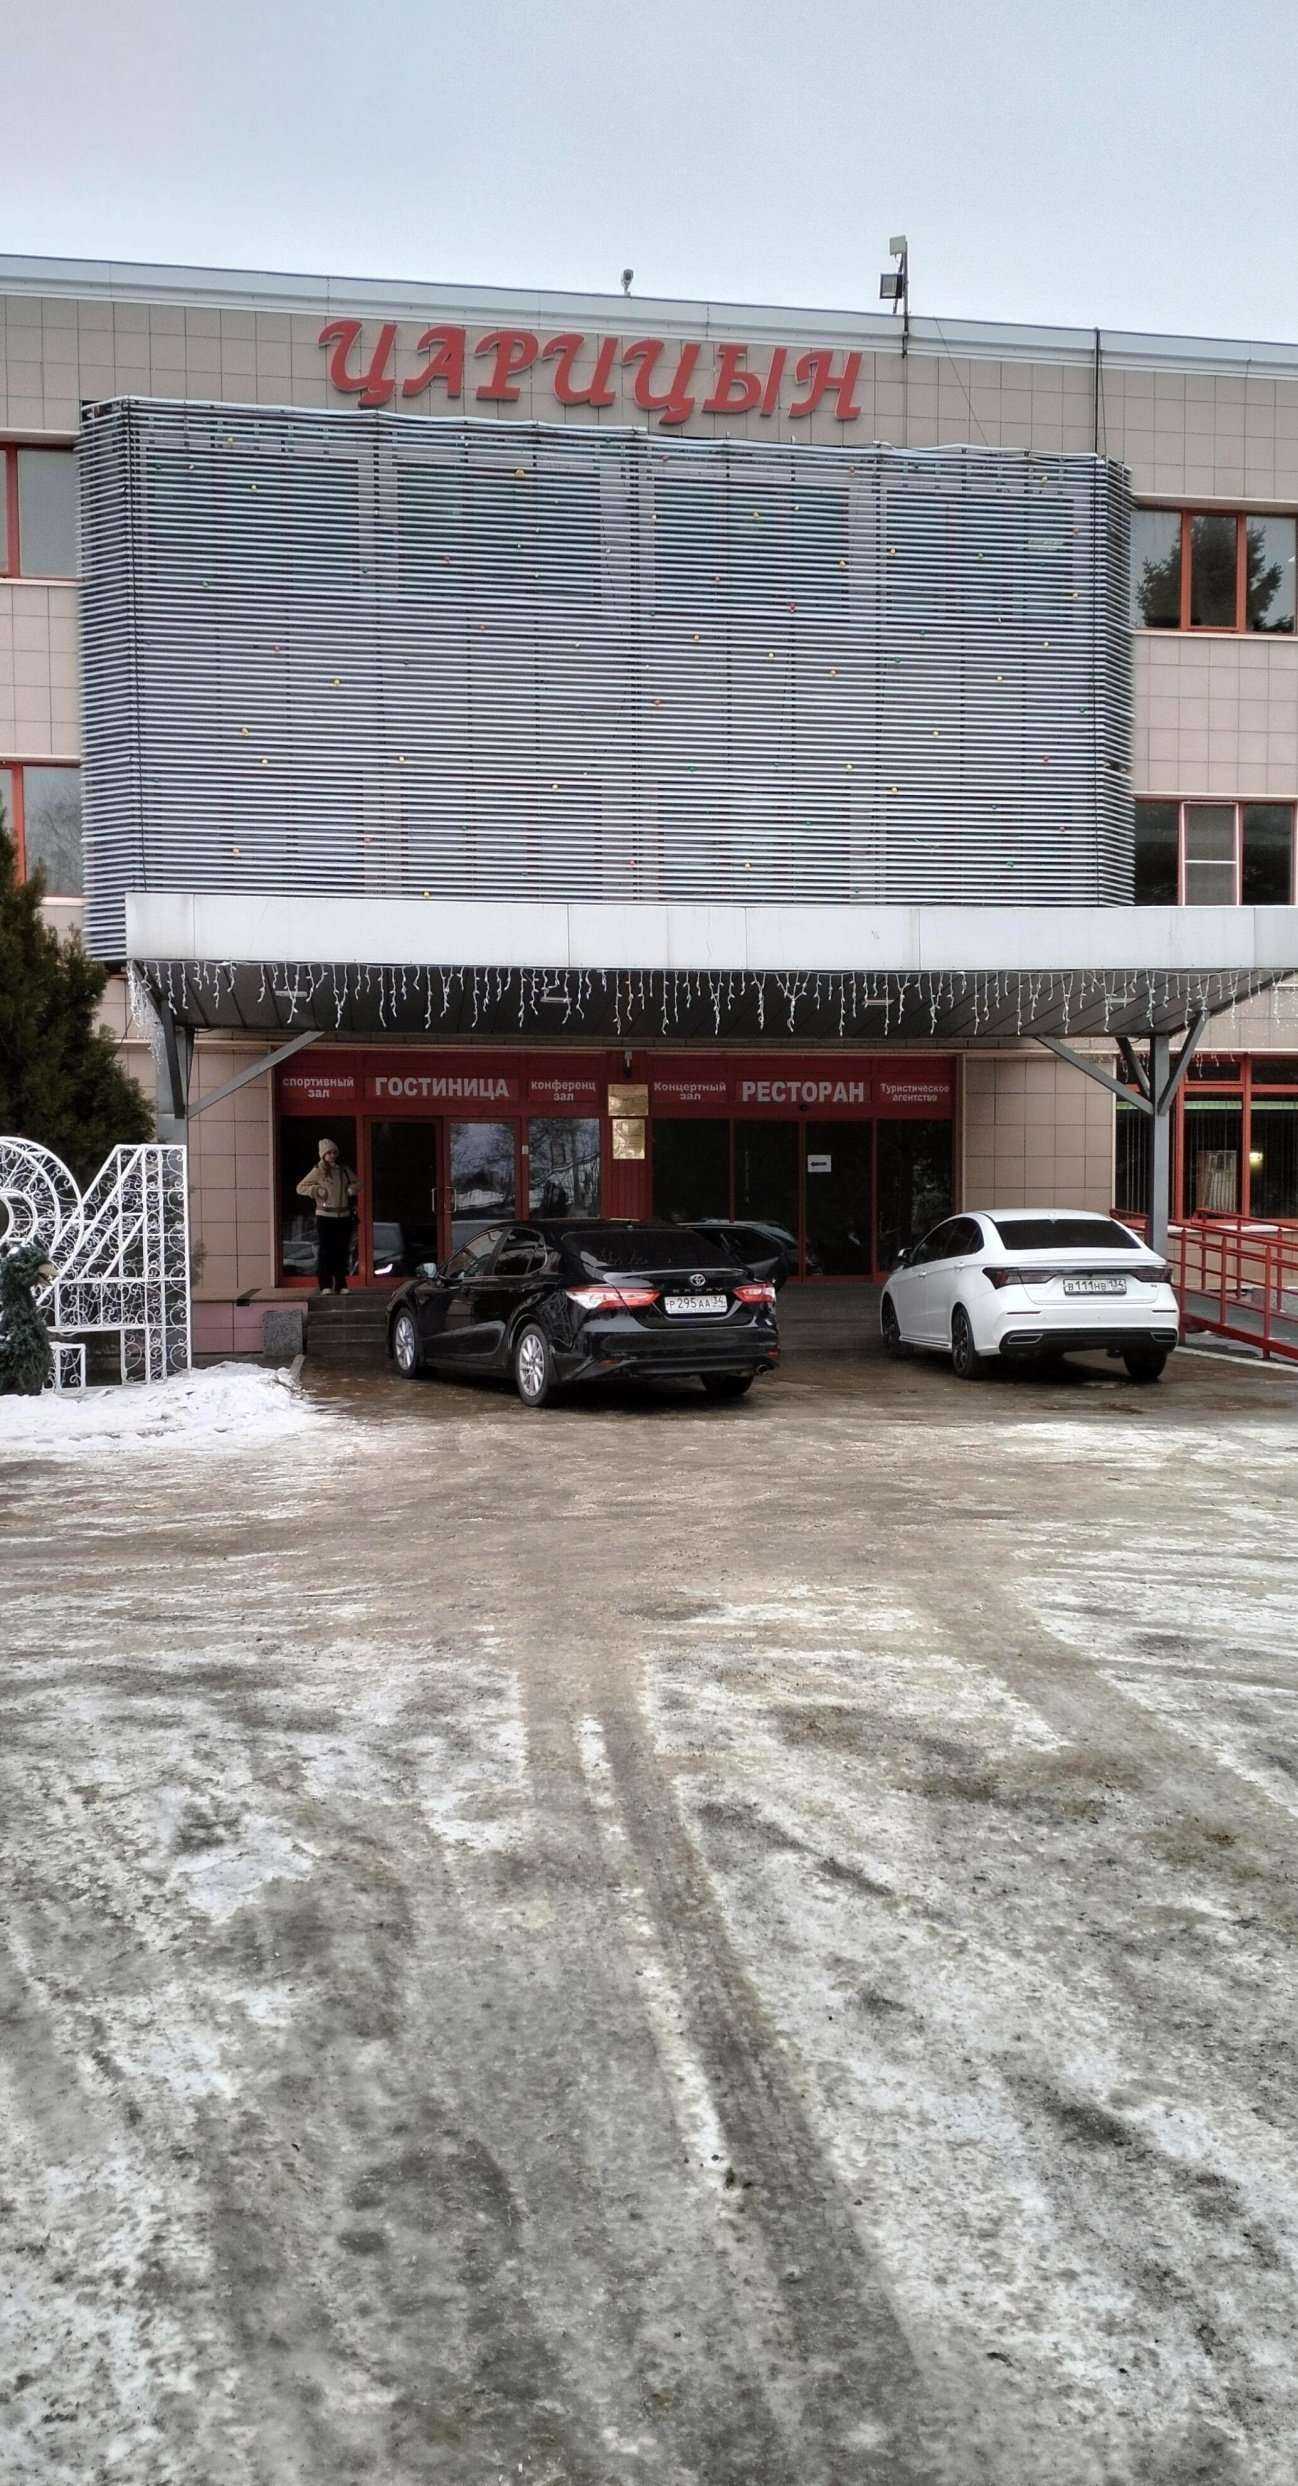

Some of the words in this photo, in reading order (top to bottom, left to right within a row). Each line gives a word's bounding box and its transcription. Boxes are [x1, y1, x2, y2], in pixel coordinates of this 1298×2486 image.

[318, 320, 863, 425] ЦАРИЦЫН
[282, 1075, 355, 1088] спортивный
[375, 1076, 511, 1100] ГОСТИНИЦА
[530, 1079, 597, 1093] конференц
[653, 1080, 727, 1094] Концертный
[307, 1088, 330, 1099] зал
[552, 1091, 575, 1102] зал
[679, 1091, 702, 1101] зал
[741, 1080, 865, 1103] РЕСТОРАН
